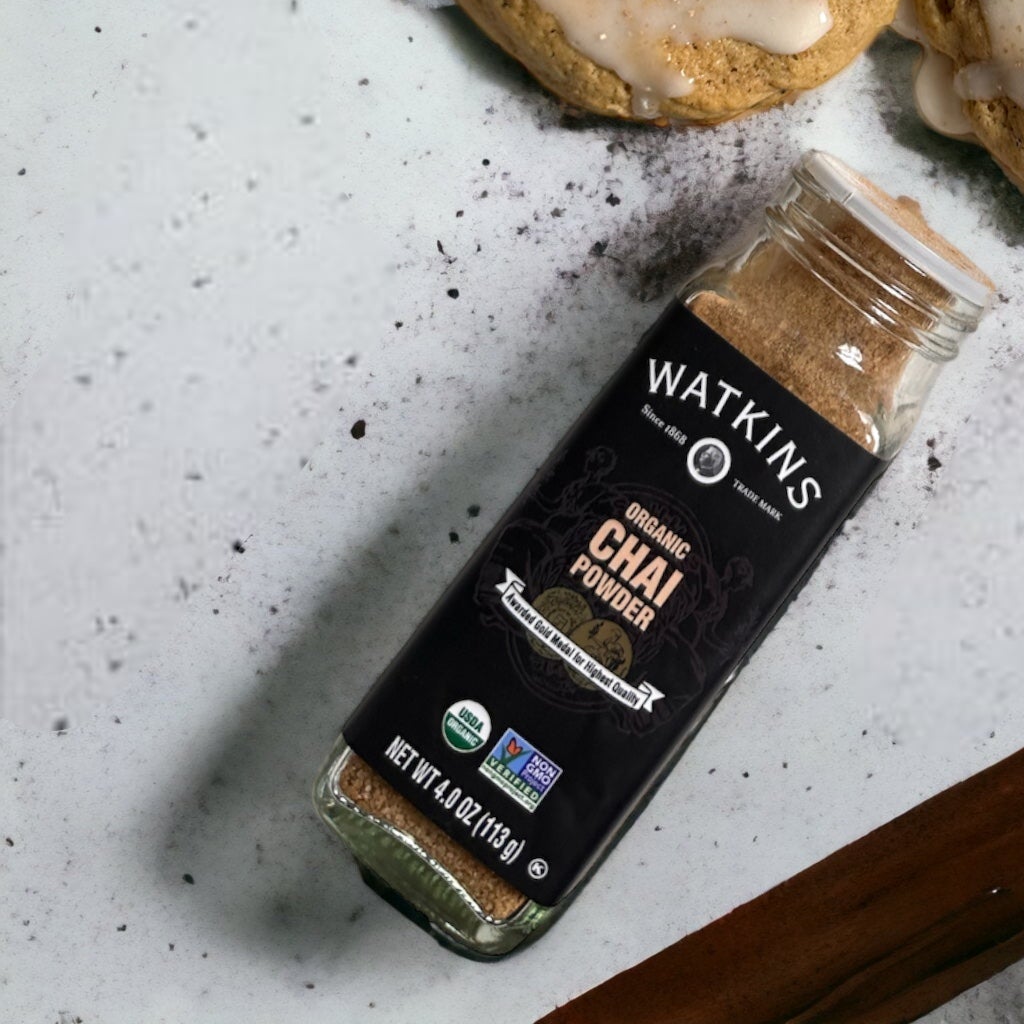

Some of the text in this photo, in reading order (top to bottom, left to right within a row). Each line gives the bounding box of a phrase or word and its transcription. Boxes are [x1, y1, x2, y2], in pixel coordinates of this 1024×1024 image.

[641, 404, 688, 446] Since 1868
[649, 358, 822, 510] WATKINS
[732, 478, 783, 522] TRADE MARK
[625, 502, 691, 560] ORGANIC
[589, 519, 685, 607] CHAI
[569, 554, 656, 632] POWDER
[505, 593, 536, 625] Awarded
[534, 620, 553, 640] Gold
[550, 634, 575, 657] Medal
[572, 652, 585, 666] for
[584, 659, 613, 688] Highest
[612, 682, 640, 707] Quality
[447, 717, 478, 746] ORGANIC
[459, 706, 484, 733] USDA
[489, 758, 539, 801] VERIFIED
[526, 763, 551, 786] GMO
[531, 755, 557, 778] NON
[385, 735, 526, 864] NET WT 4.0 OZ (113 g)
